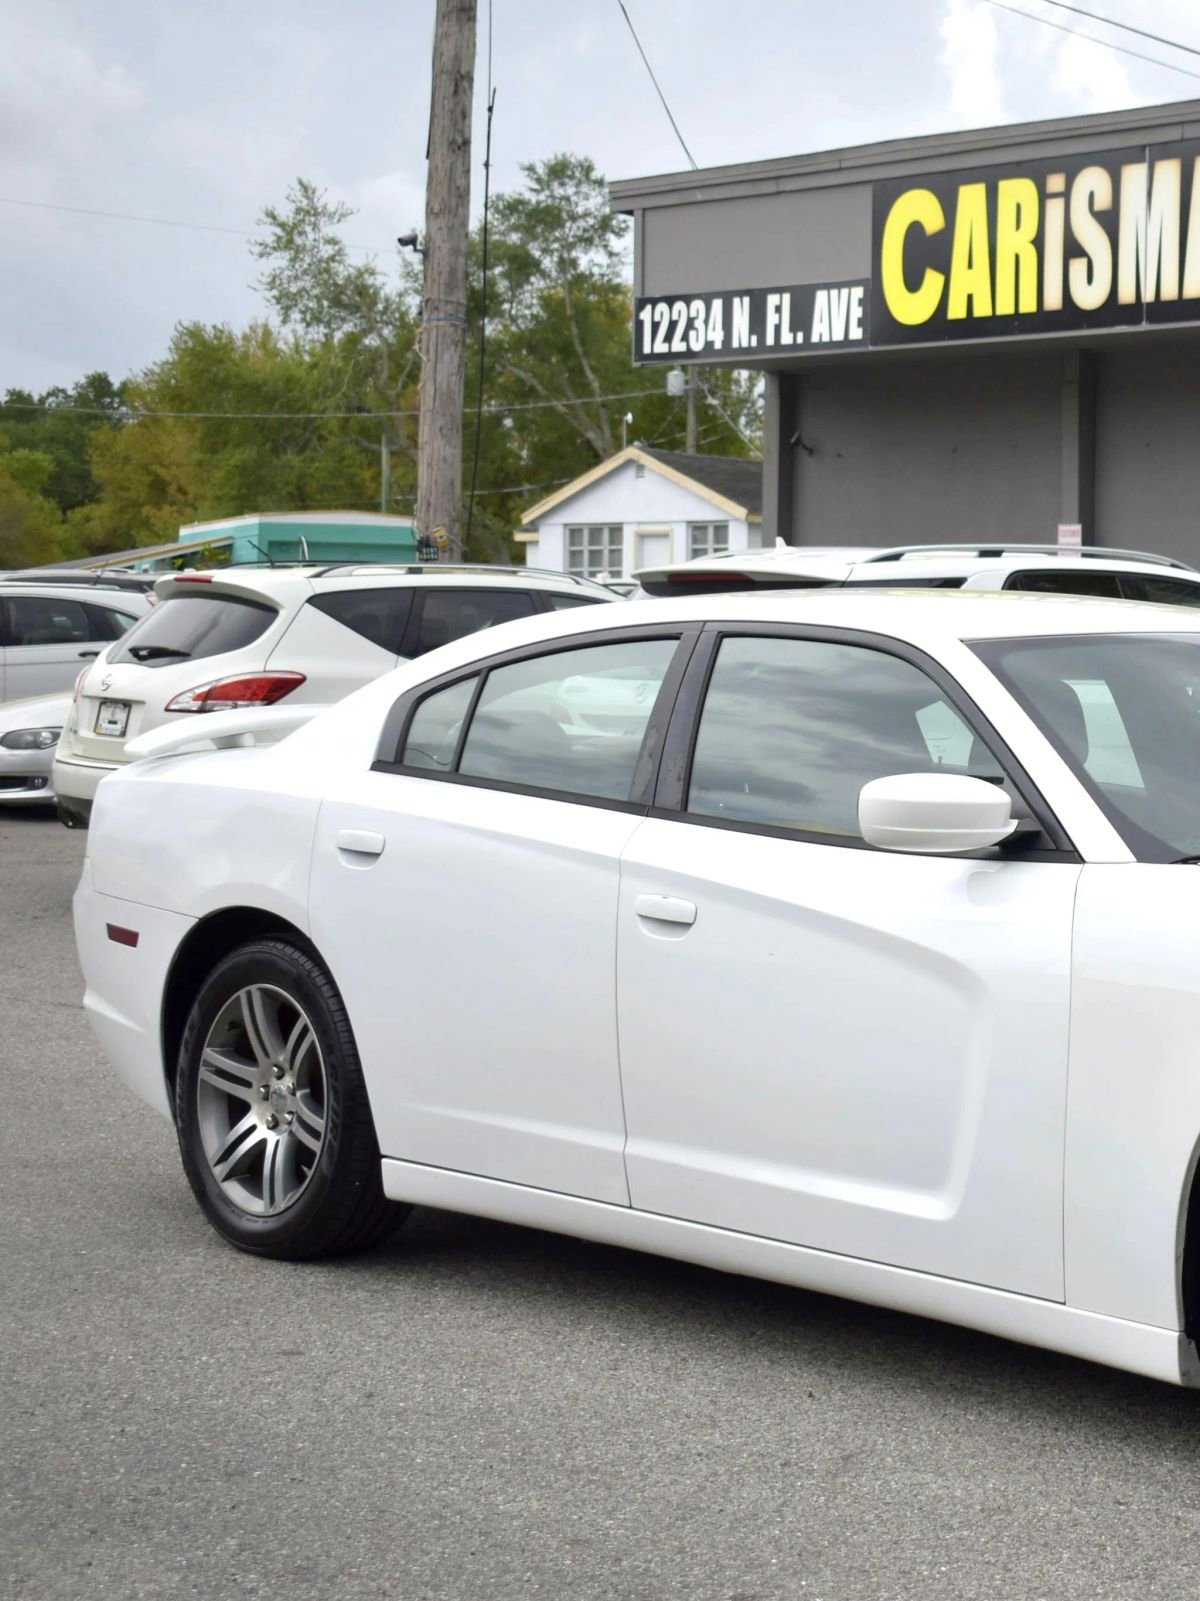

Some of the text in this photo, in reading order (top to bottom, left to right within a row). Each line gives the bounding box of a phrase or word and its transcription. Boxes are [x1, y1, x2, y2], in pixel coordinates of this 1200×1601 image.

[639, 286, 864, 354] 12234 N. FL. AVE
